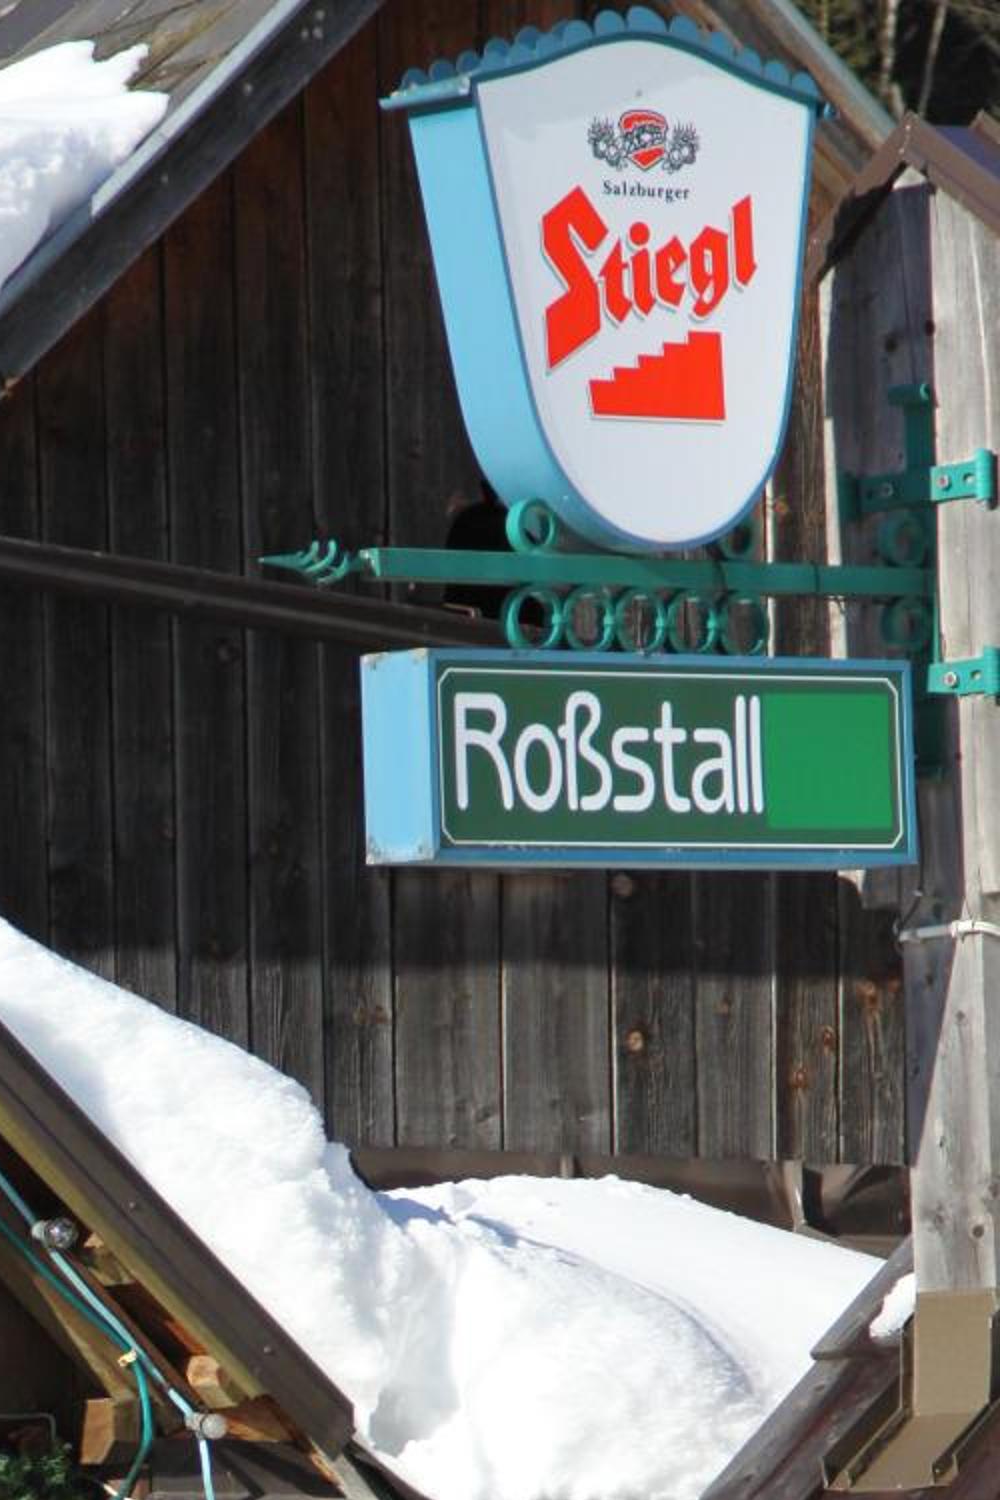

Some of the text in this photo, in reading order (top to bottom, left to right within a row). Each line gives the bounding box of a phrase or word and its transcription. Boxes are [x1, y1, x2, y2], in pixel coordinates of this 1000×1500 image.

[603, 180, 690, 203] Salzburger
[542, 186, 757, 371] Stiegl
[454, 691, 764, 813] Roßstall
